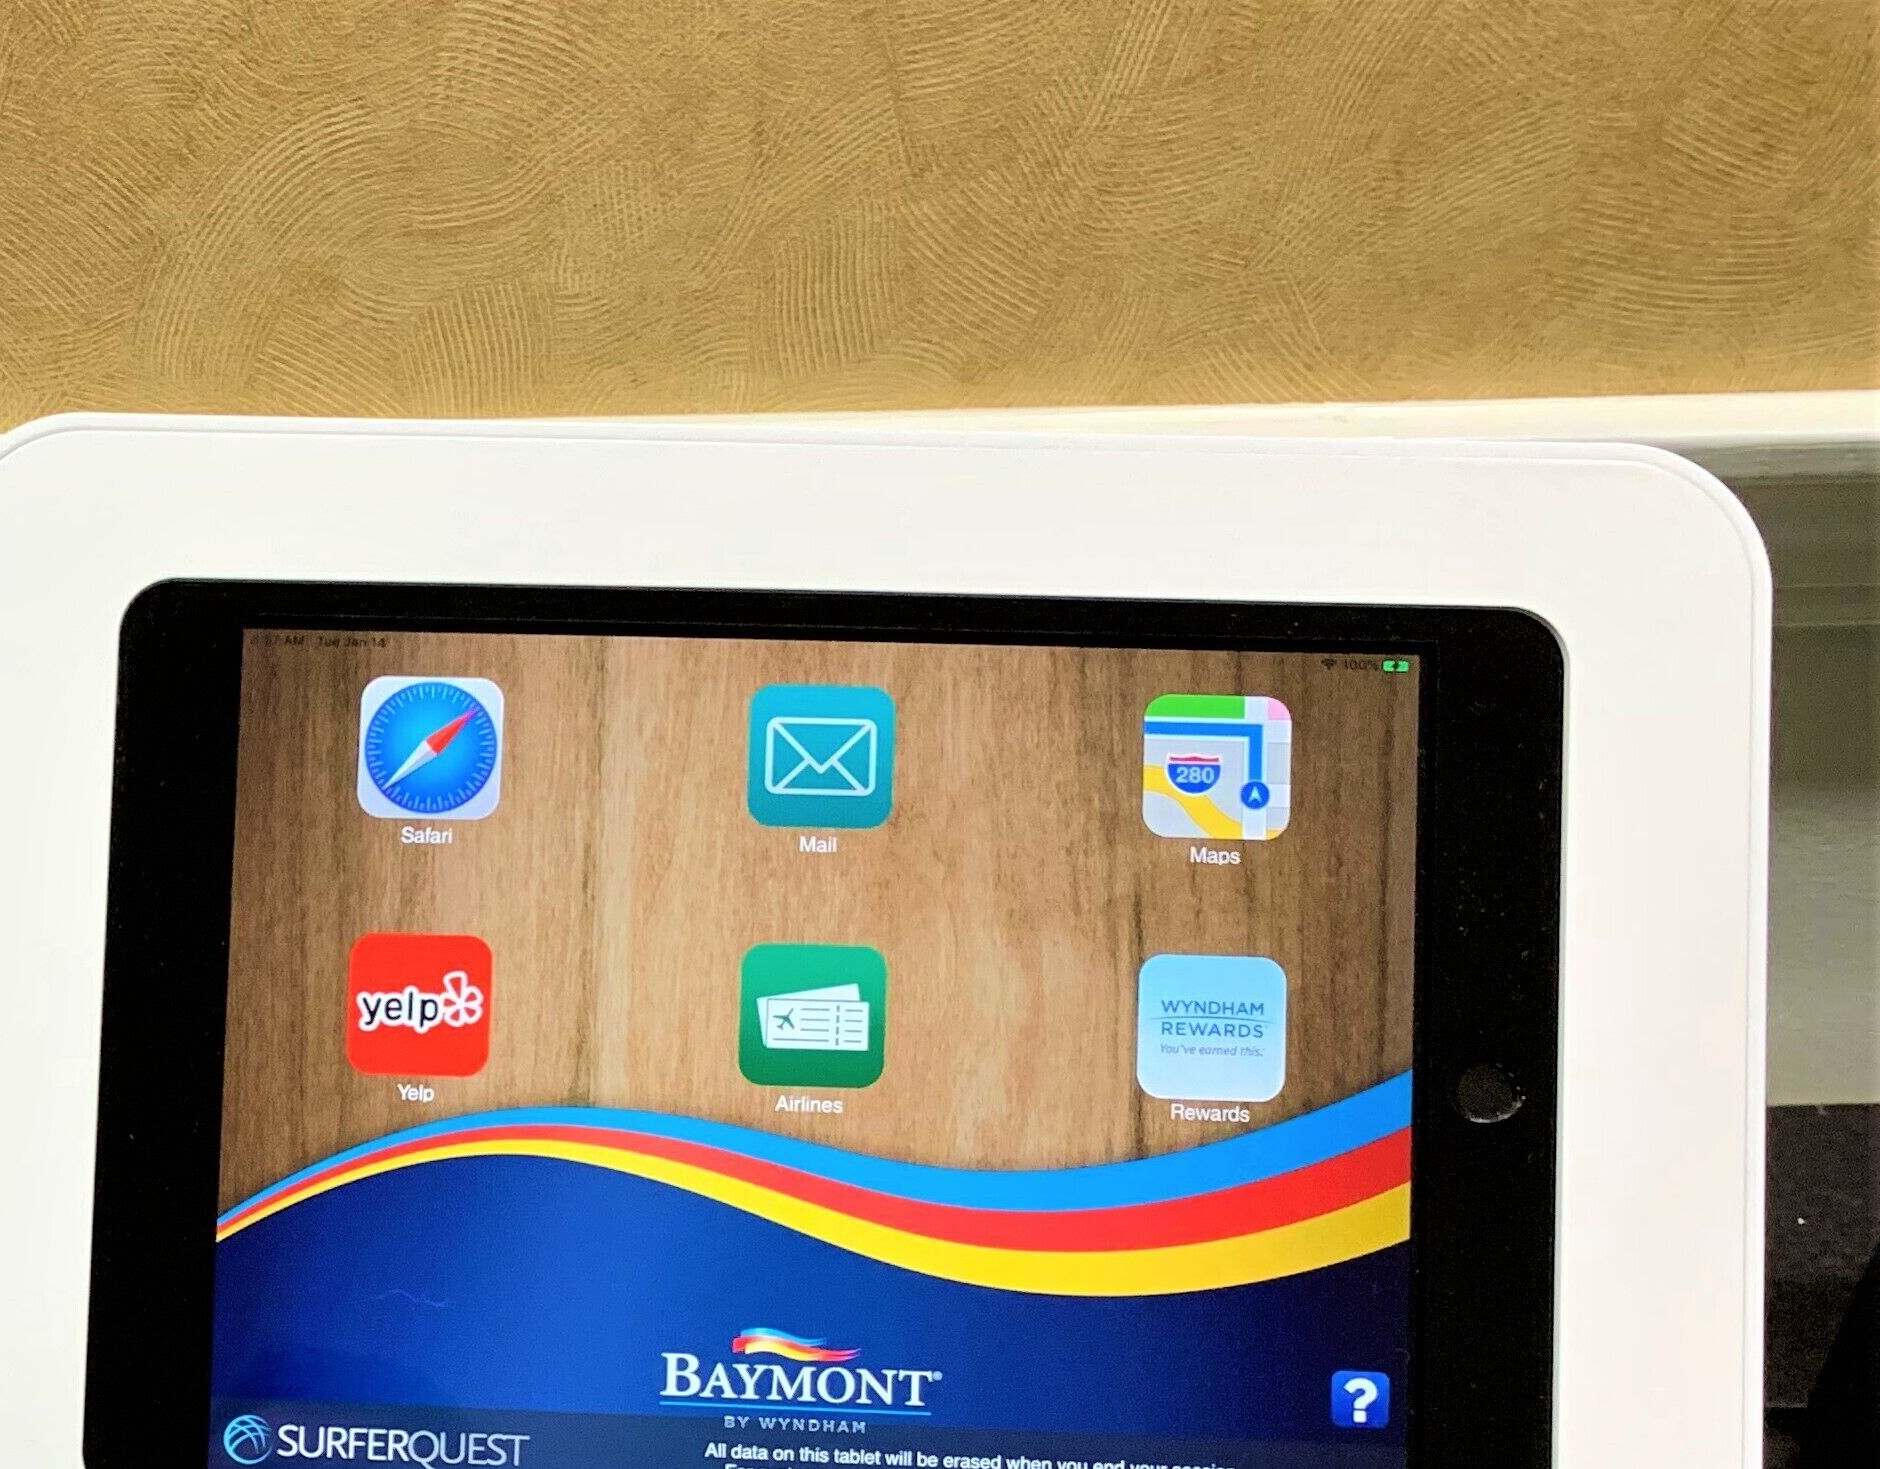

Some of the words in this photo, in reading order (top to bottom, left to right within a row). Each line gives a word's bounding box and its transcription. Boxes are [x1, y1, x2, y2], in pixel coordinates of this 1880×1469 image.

[1176, 766, 1215, 784] 280
[400, 825, 453, 844] Safari
[799, 835, 838, 853] Mail
[1189, 846, 1242, 866] Maps
[360, 990, 440, 1029] yelp
[1160, 999, 1265, 1016] WYNDHAM
[1161, 1021, 1264, 1039] REWARDS
[1160, 1044, 1196, 1055] You've
[1198, 1045, 1238, 1056] earned
[396, 1083, 435, 1103] Yelp
[774, 1094, 844, 1114] Airlines
[1170, 1103, 1251, 1123] Rewards
[723, 1415, 750, 1430] BY
[758, 1416, 867, 1434] WYNDHAM
[704, 1442, 727, 1458] All
[731, 1444, 769, 1461] data
[772, 1449, 795, 1462] on
[799, 1446, 830, 1463] this
[833, 1448, 881, 1465] tablet
[884, 1450, 912, 1467] will
[916, 1451, 939, 1468] be
